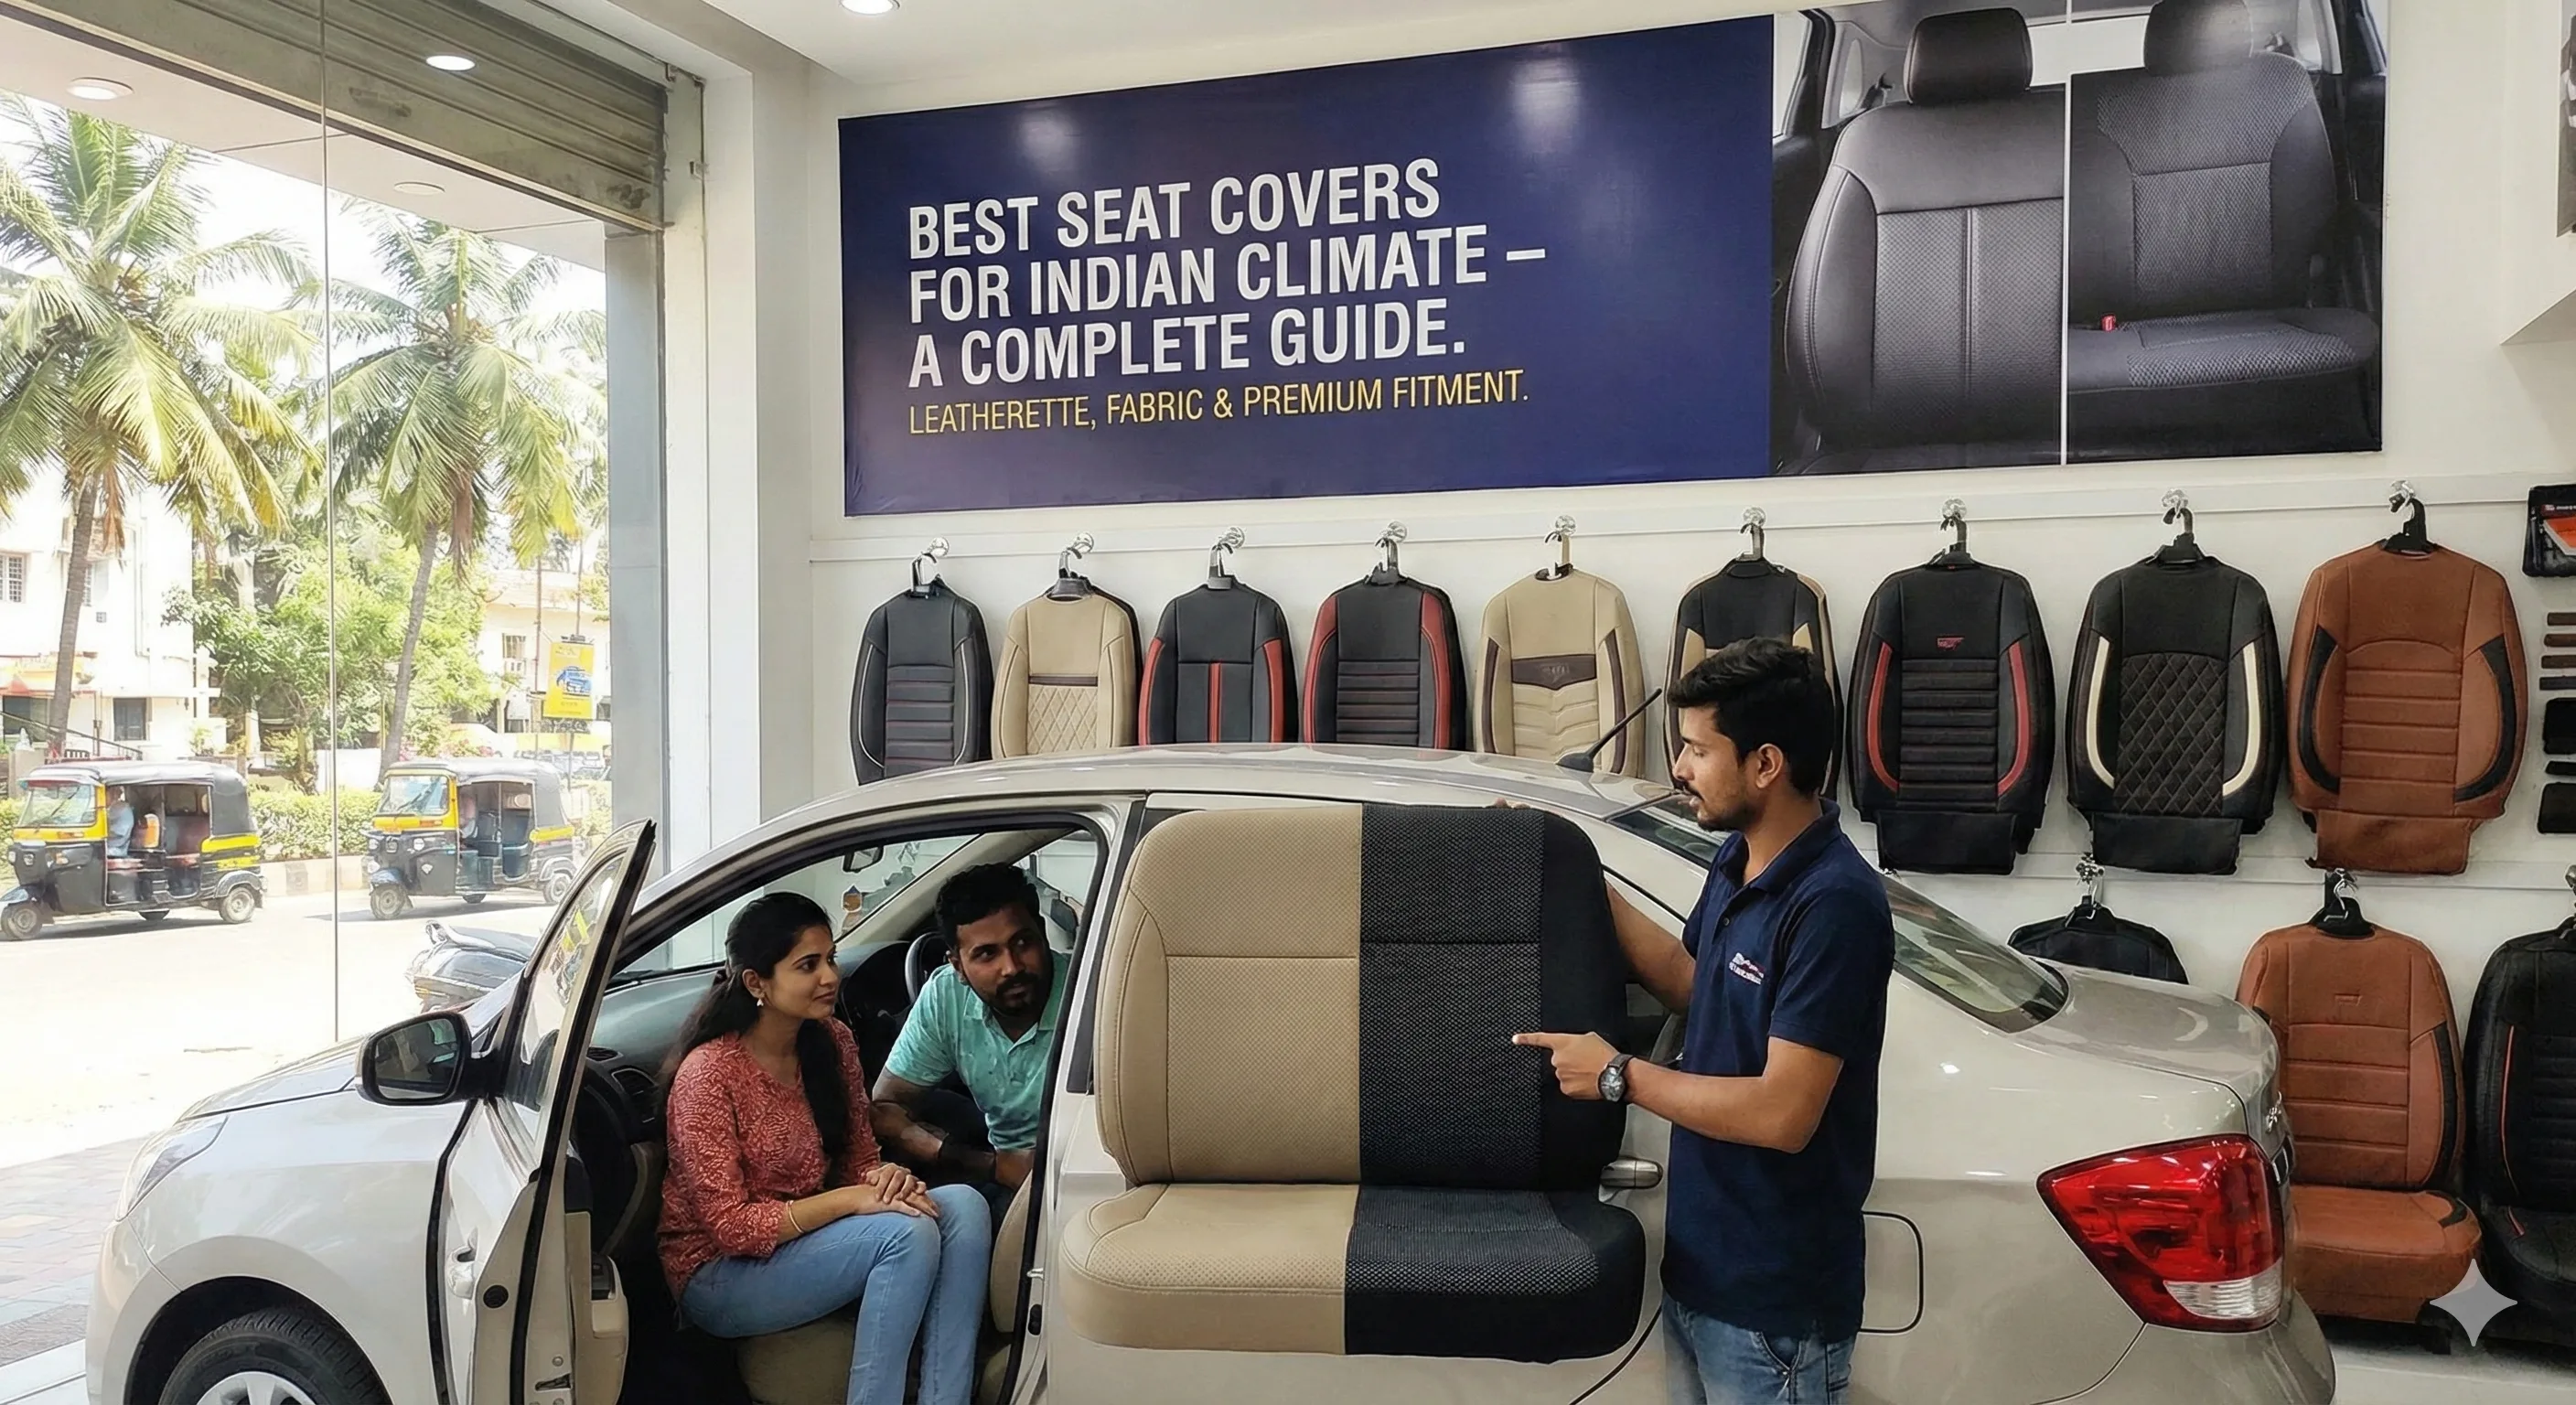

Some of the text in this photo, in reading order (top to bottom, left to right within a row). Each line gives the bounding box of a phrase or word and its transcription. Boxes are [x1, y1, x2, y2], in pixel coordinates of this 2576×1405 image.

[909, 157, 1441, 260] BEST SEAT COVERS
[910, 265, 1011, 324] FOR
[1030, 248, 1215, 315] INDIAN
[1237, 225, 1487, 301] CLIMATE
[907, 298, 1465, 389] A COMPLETE GUIDE.
[909, 370, 1530, 435] LEATHERETTE, FABRIC & PREMIUM FITMENT.
